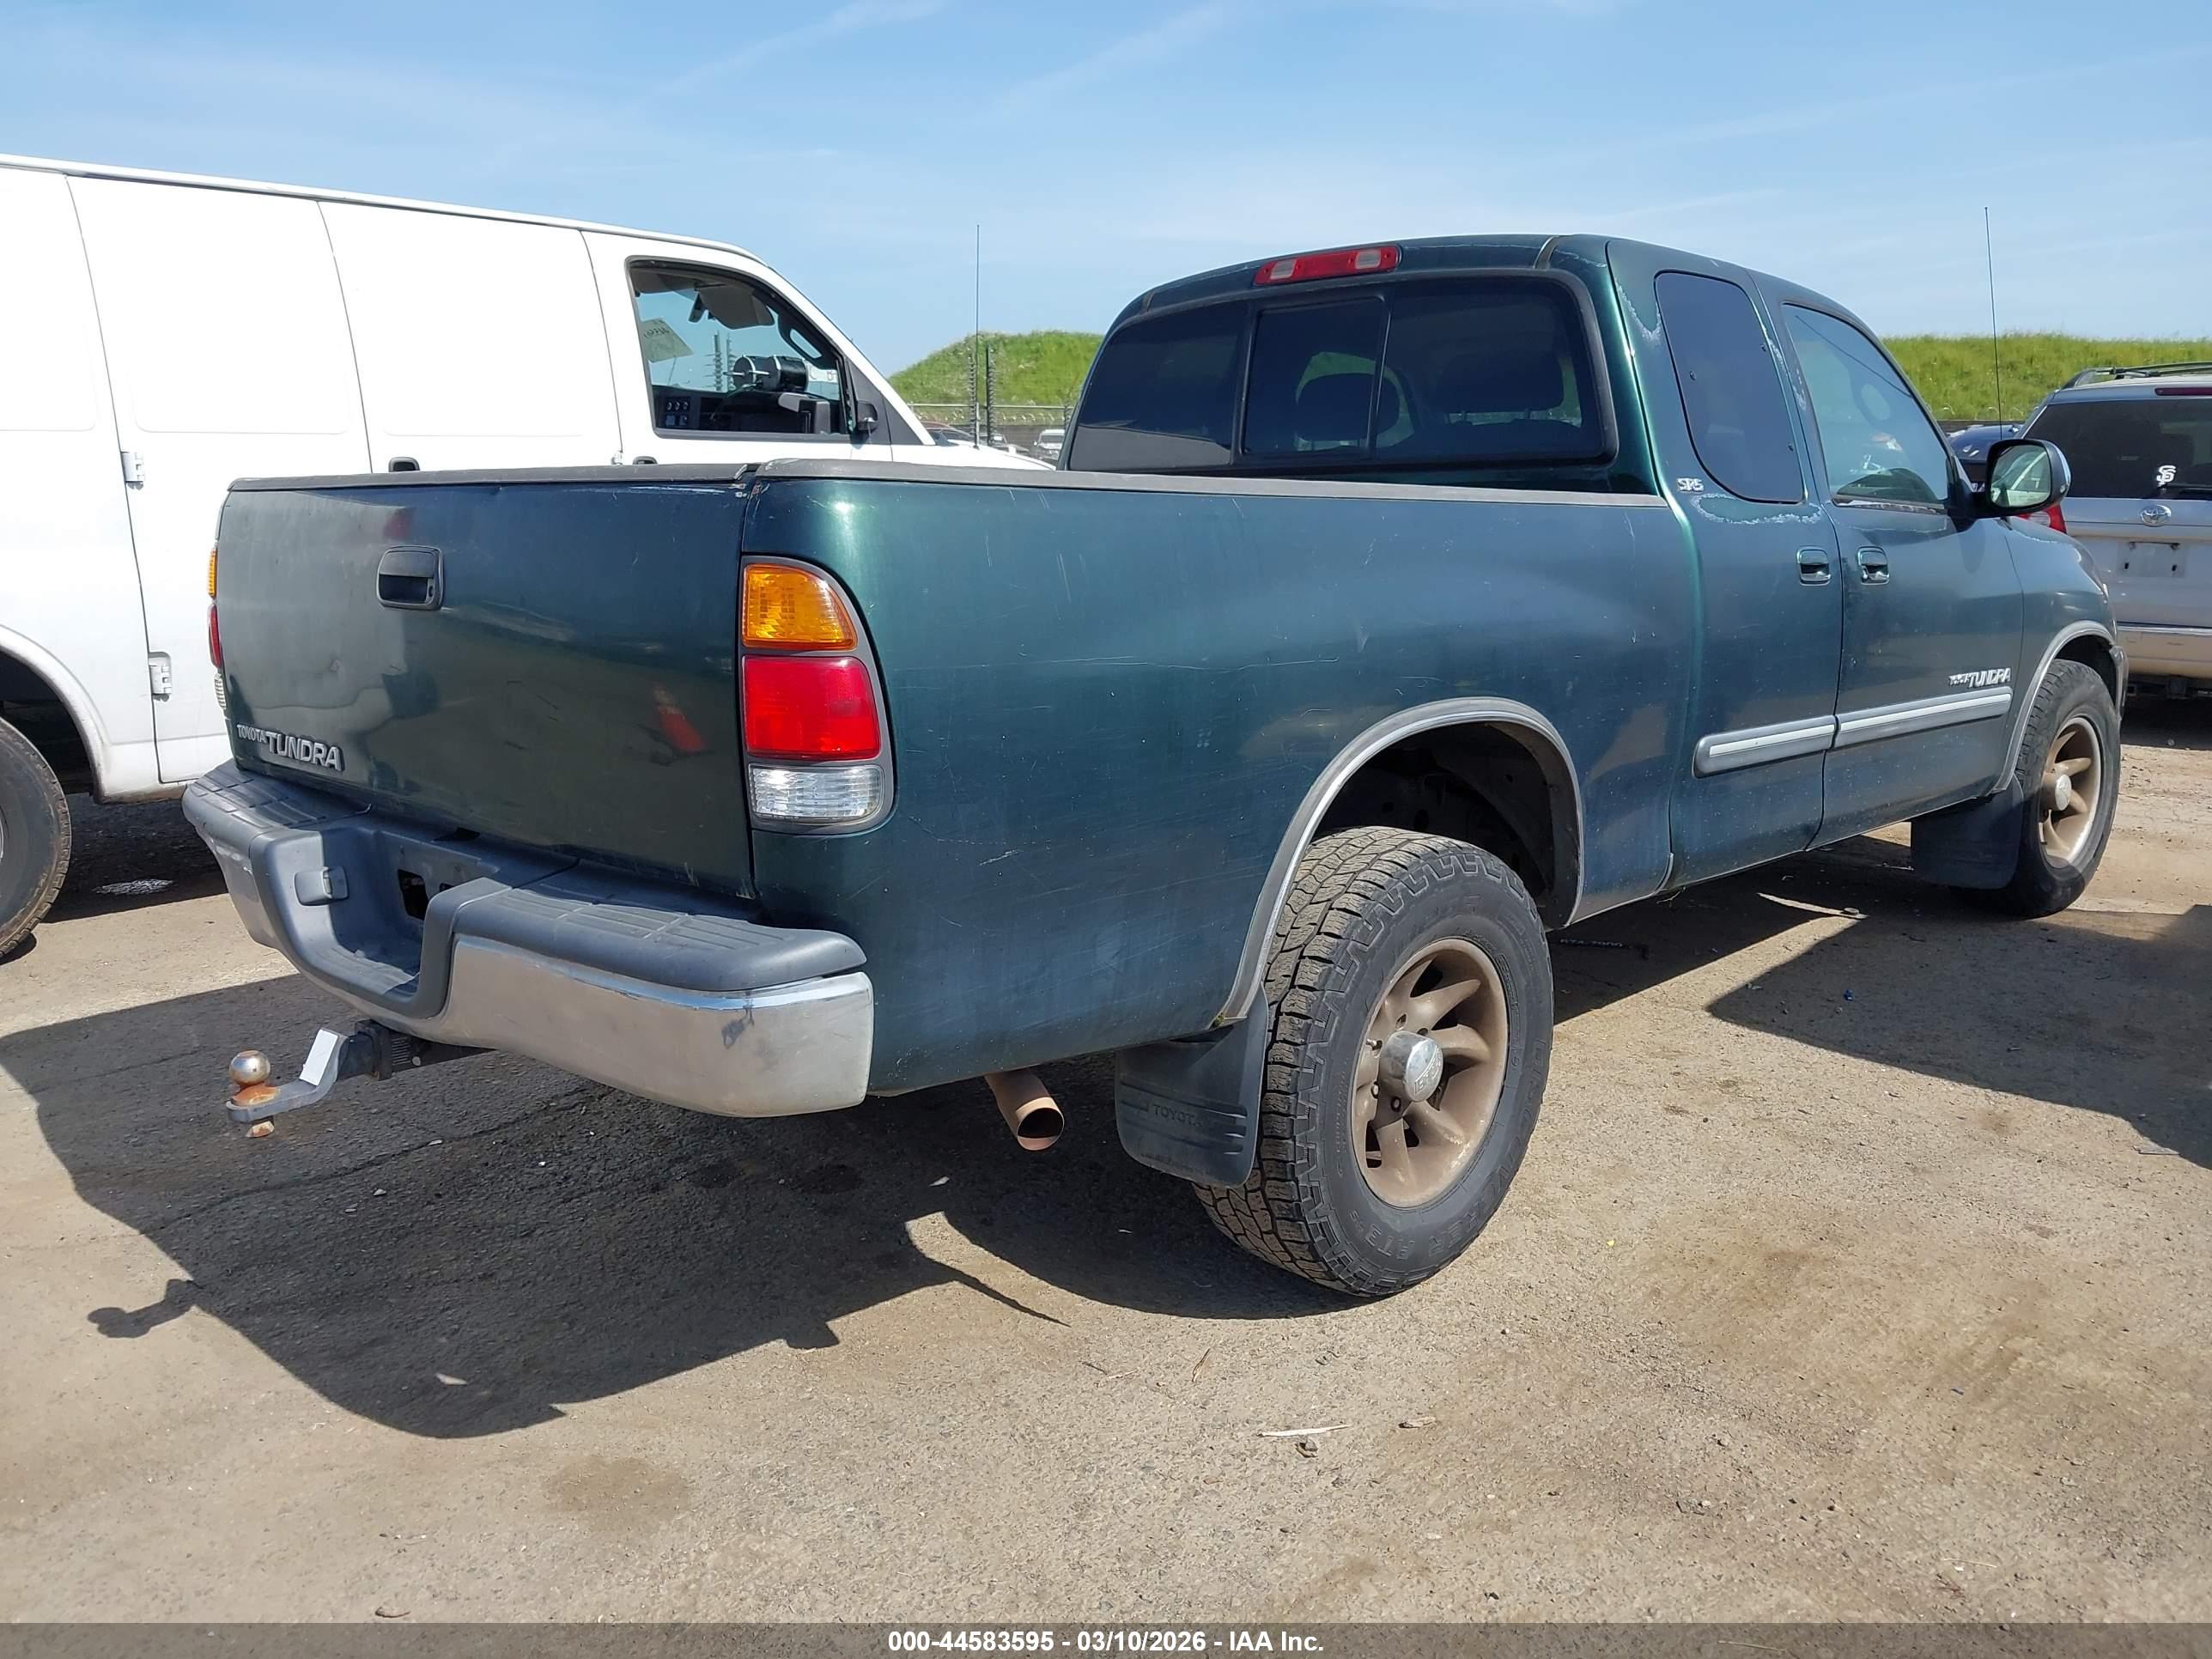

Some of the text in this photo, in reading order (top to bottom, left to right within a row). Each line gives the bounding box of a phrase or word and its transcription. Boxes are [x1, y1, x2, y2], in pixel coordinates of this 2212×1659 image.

[1968, 667, 2011, 688] TUNDRA
[236, 724, 343, 772] TOYOTA TUNDRA
